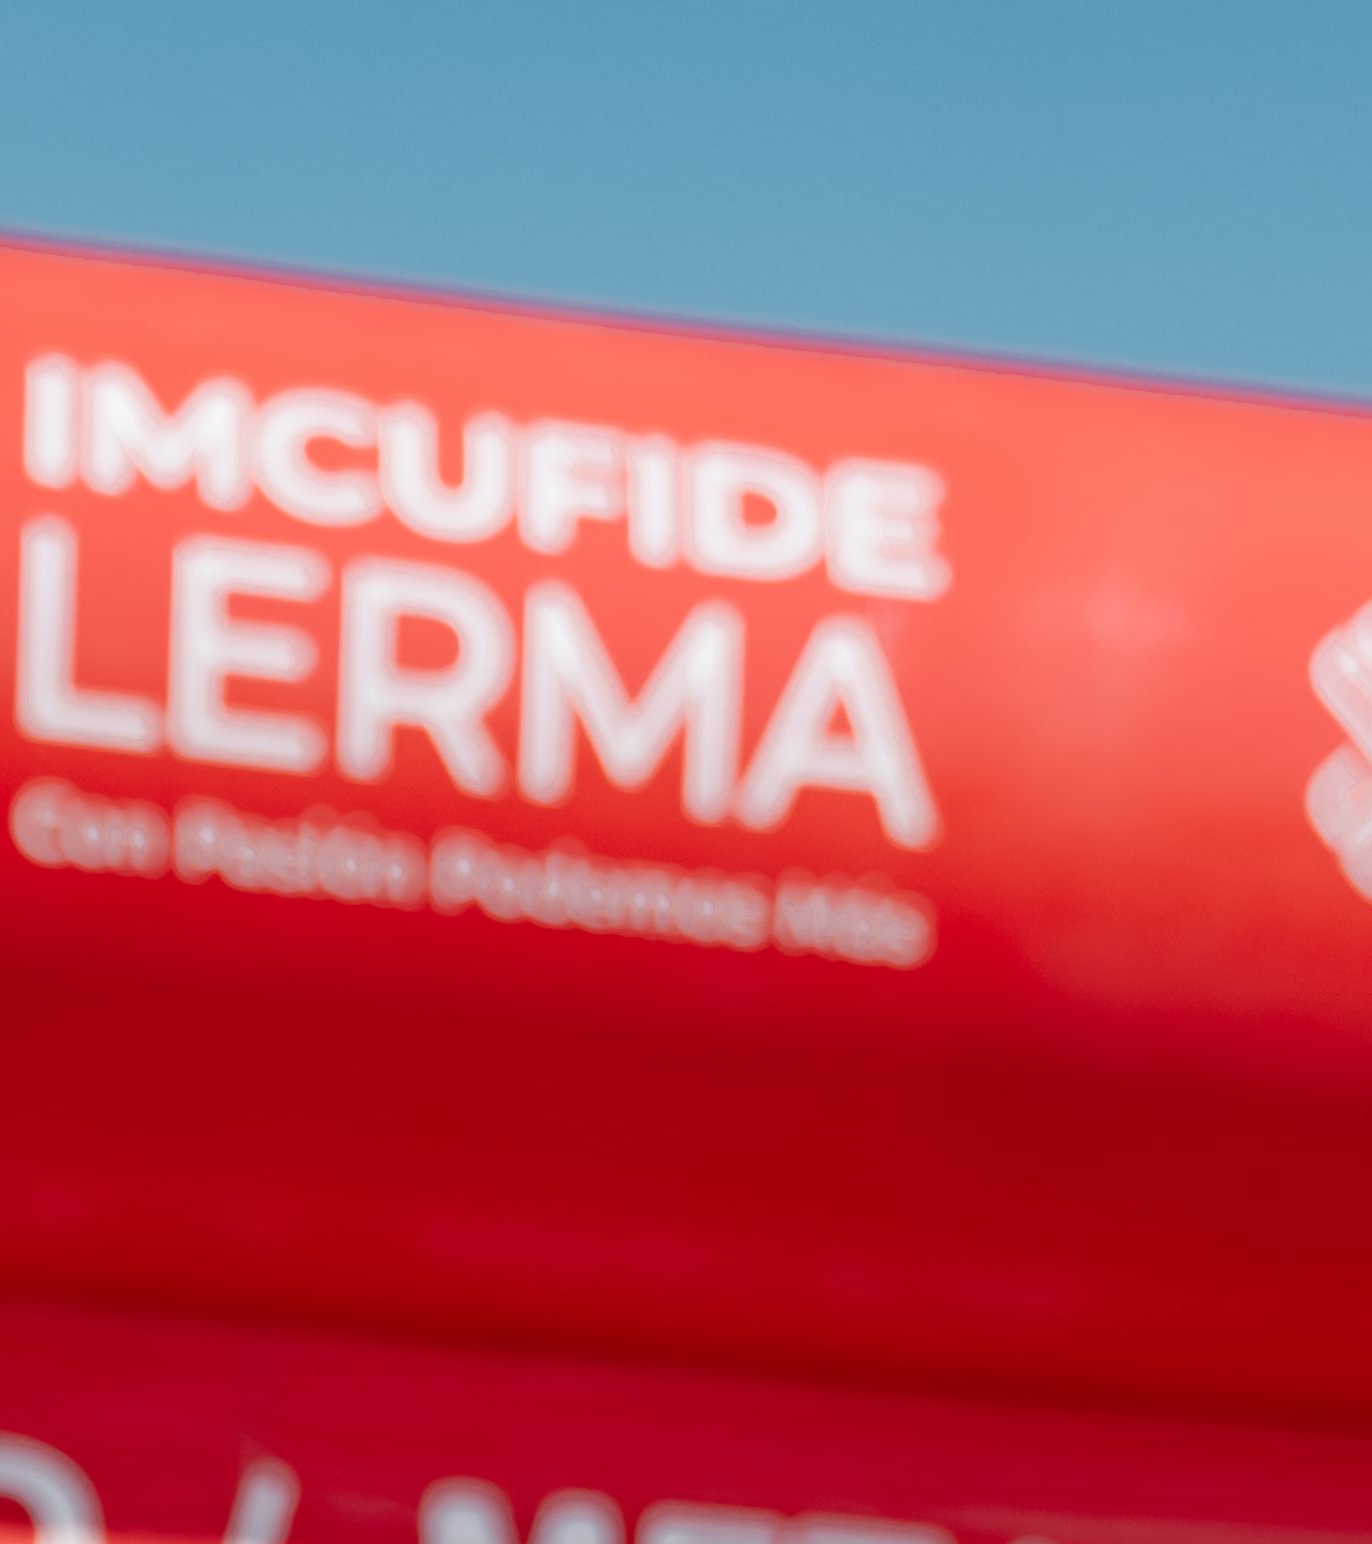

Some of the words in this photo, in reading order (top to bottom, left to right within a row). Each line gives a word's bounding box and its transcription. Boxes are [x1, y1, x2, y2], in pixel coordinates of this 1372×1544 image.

[22, 352, 952, 602] IMCUFIDE
[14, 514, 944, 852] LERMA
[10, 775, 171, 880] Con
[428, 824, 772, 954] Podemos
